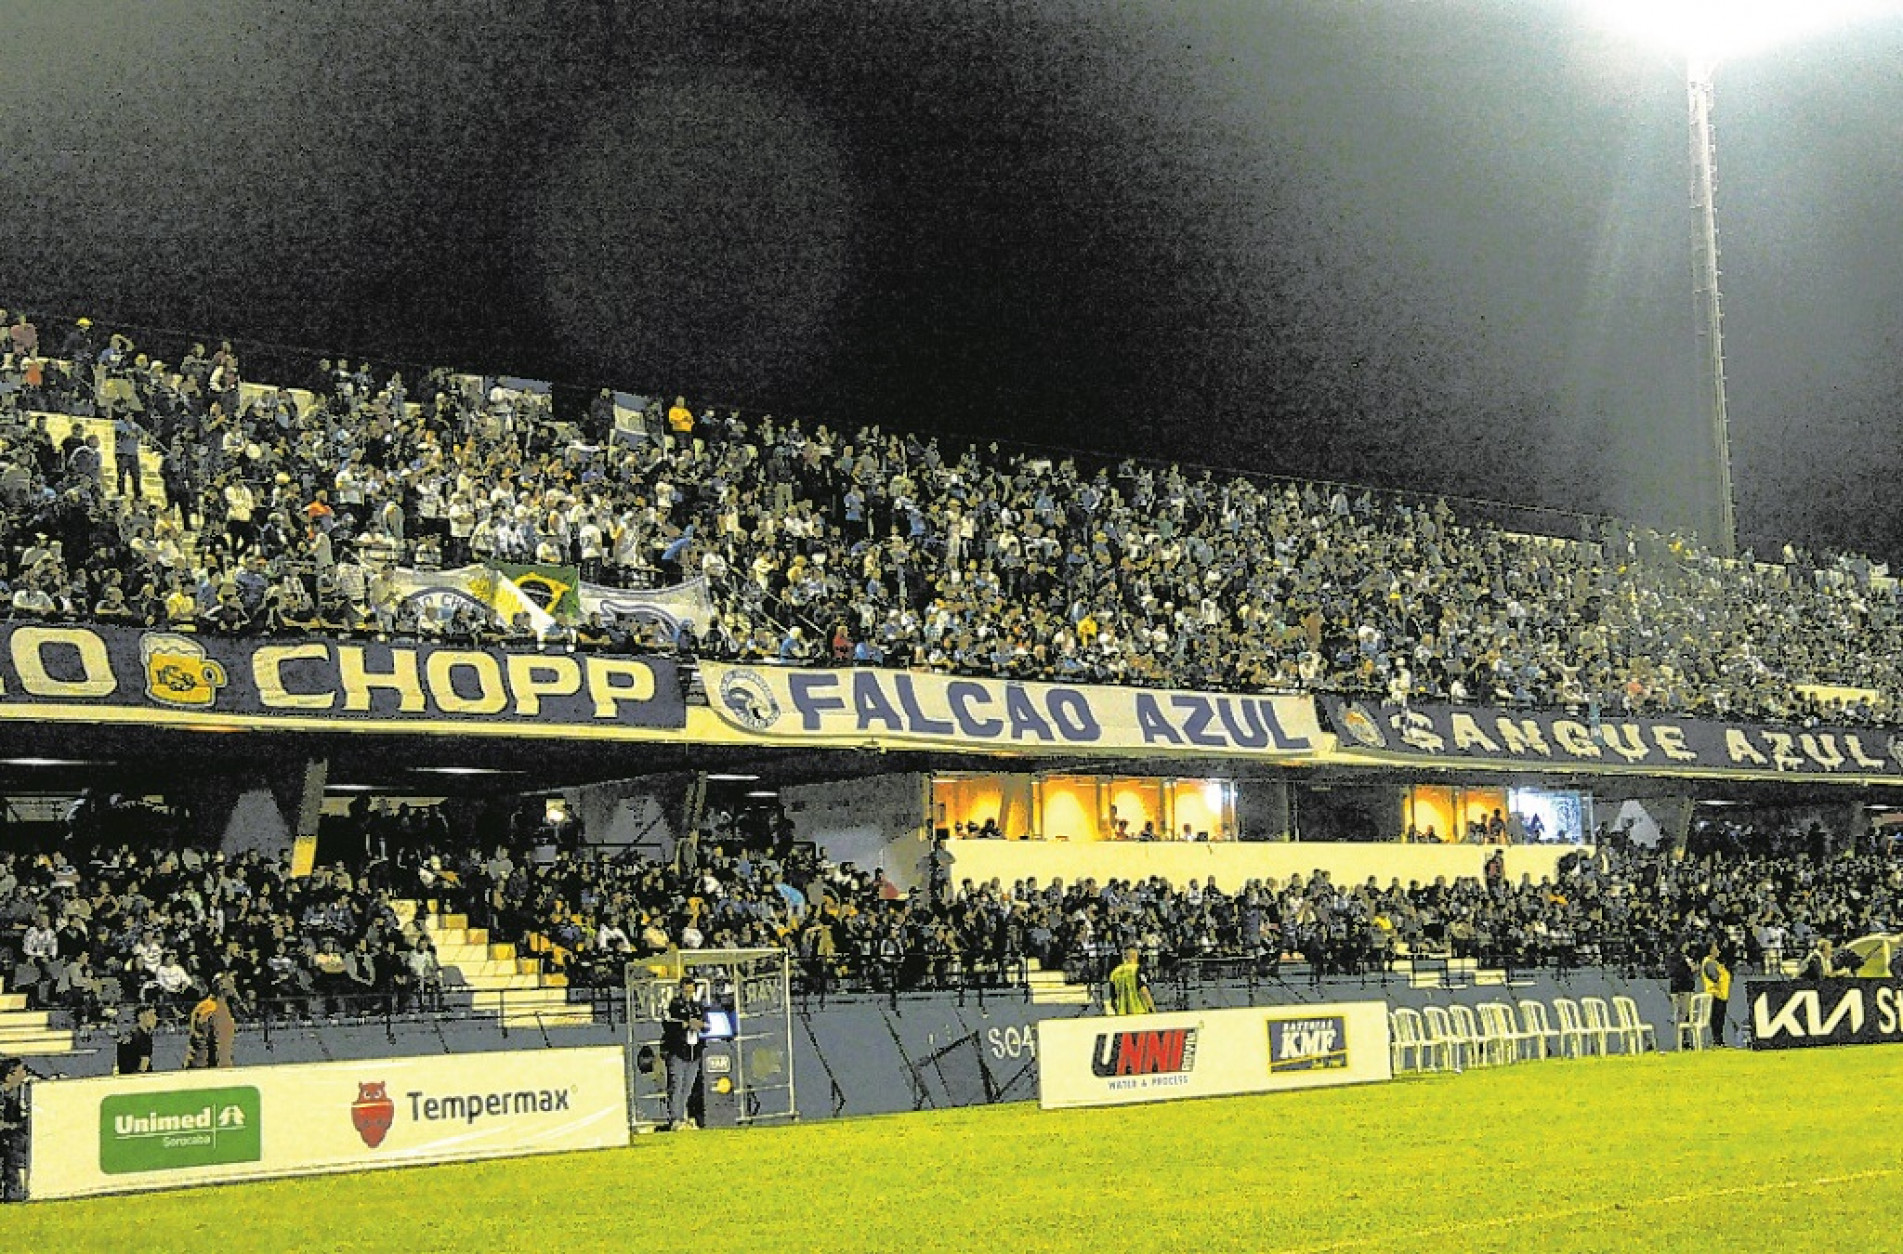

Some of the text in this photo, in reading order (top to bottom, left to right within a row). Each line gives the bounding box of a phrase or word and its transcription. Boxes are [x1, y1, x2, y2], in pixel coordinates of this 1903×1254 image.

[0, 628, 118, 696] O
[252, 644, 655, 718] CHOPP
[1136, 693, 1313, 749] AZUL
[1390, 710, 1698, 763] SANGUE
[1725, 729, 1885, 771] AZUL
[988, 1024, 1037, 1060] SOA
[1092, 1028, 1186, 1077] UNNI
[114, 1106, 211, 1134] Unimed
[406, 1088, 569, 1124] Tempermax
